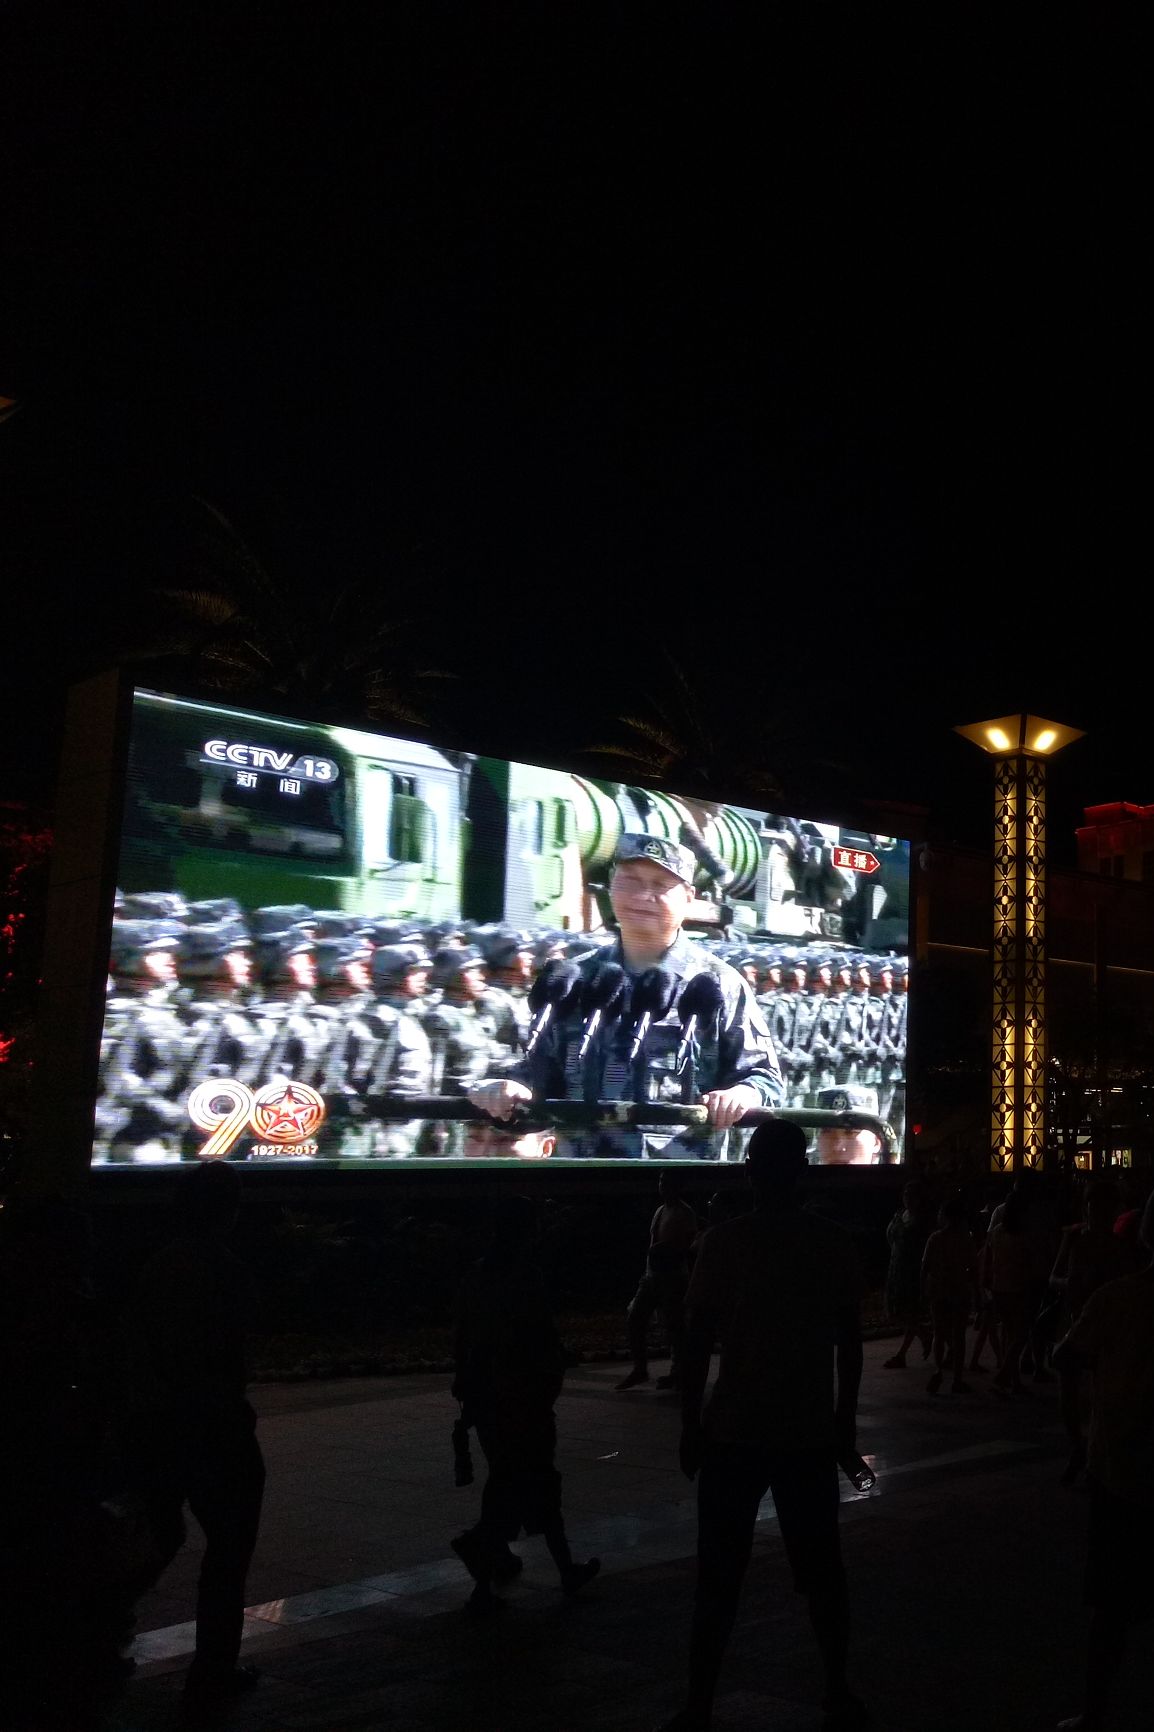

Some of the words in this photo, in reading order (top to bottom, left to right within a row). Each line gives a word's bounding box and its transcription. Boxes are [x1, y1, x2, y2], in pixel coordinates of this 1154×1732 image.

[204, 740, 293, 770] CCTV
[303, 759, 332, 780] 13
[838, 851, 867, 869] 直播
[251, 1144, 318, 1156] 1927-2017
